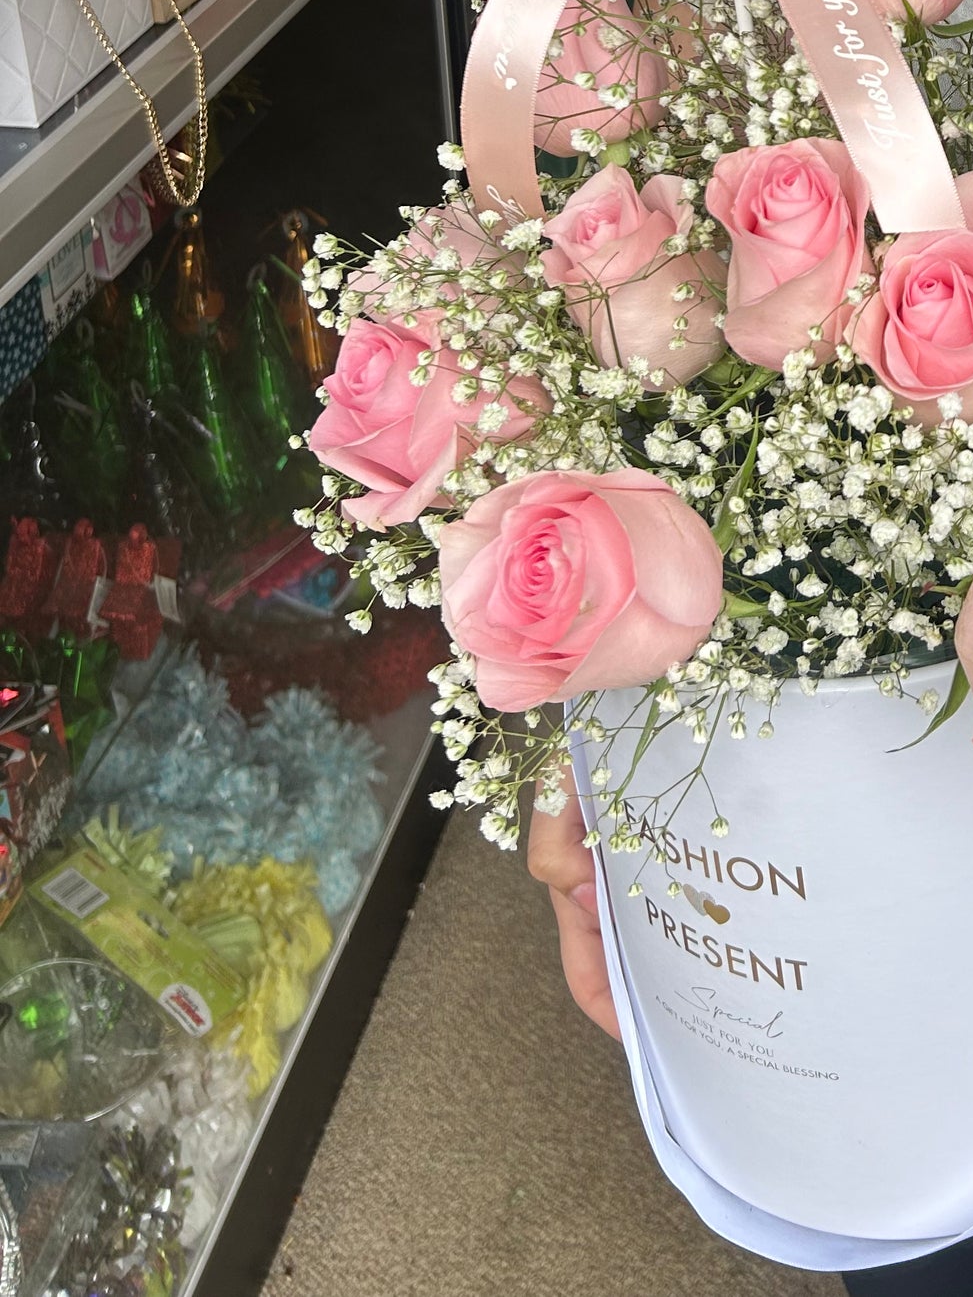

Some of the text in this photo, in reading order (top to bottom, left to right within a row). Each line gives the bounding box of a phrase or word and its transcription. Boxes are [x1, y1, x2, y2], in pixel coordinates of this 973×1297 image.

[832, 19, 890, 77] for
[856, 72, 914, 150] Just
[622, 799, 807, 901] FASHION
[644, 895, 808, 991] PRESENT
[673, 986, 784, 1039] Special
[691, 1013, 776, 1058] JUST FOR YOU
[737, 1051, 781, 1072] SPECIAL
[782, 1063, 841, 1082] BLESSING
